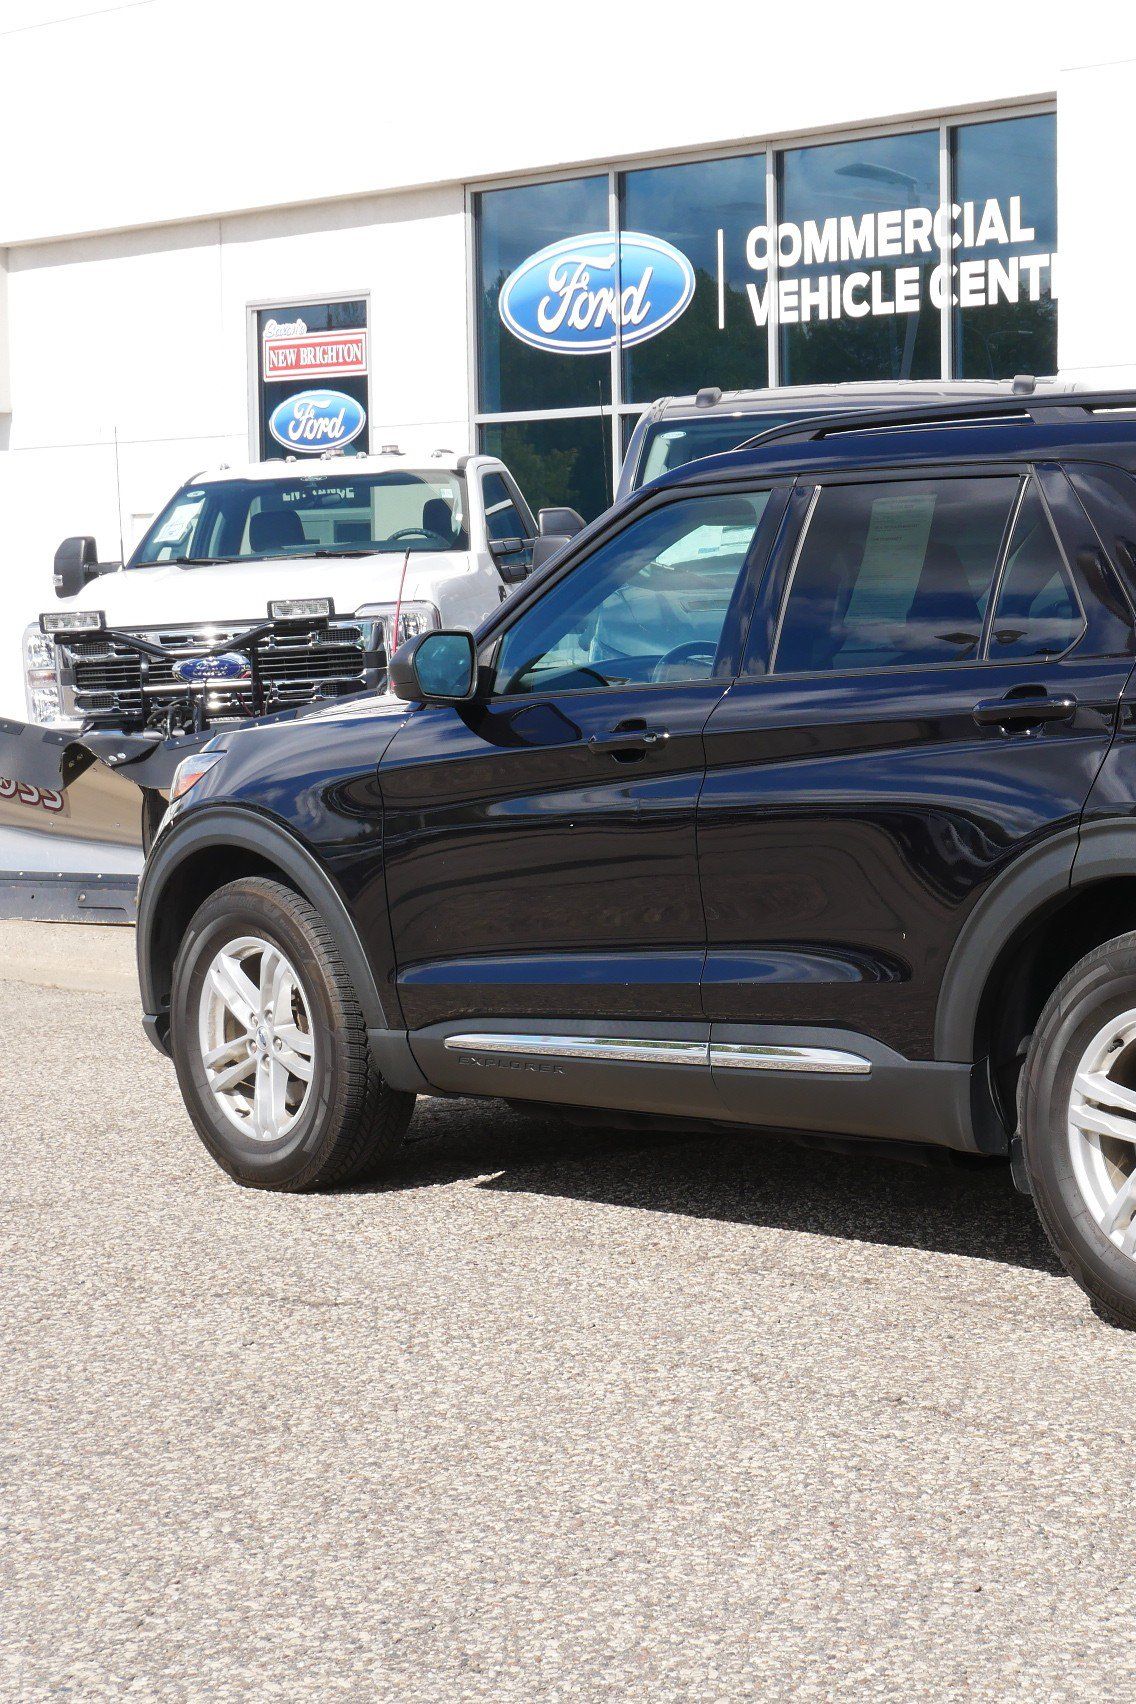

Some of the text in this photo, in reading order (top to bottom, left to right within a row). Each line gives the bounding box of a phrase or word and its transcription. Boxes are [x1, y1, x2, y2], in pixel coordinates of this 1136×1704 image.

[746, 195, 1035, 270] COMMERCIAL
[537, 254, 651, 333] Ford
[746, 266, 920, 327] VEHICLE
[269, 342, 363, 368] NEW BRIGHTON
[288, 399, 347, 441] Ford
[458, 1056, 567, 1075] EXPLORER
